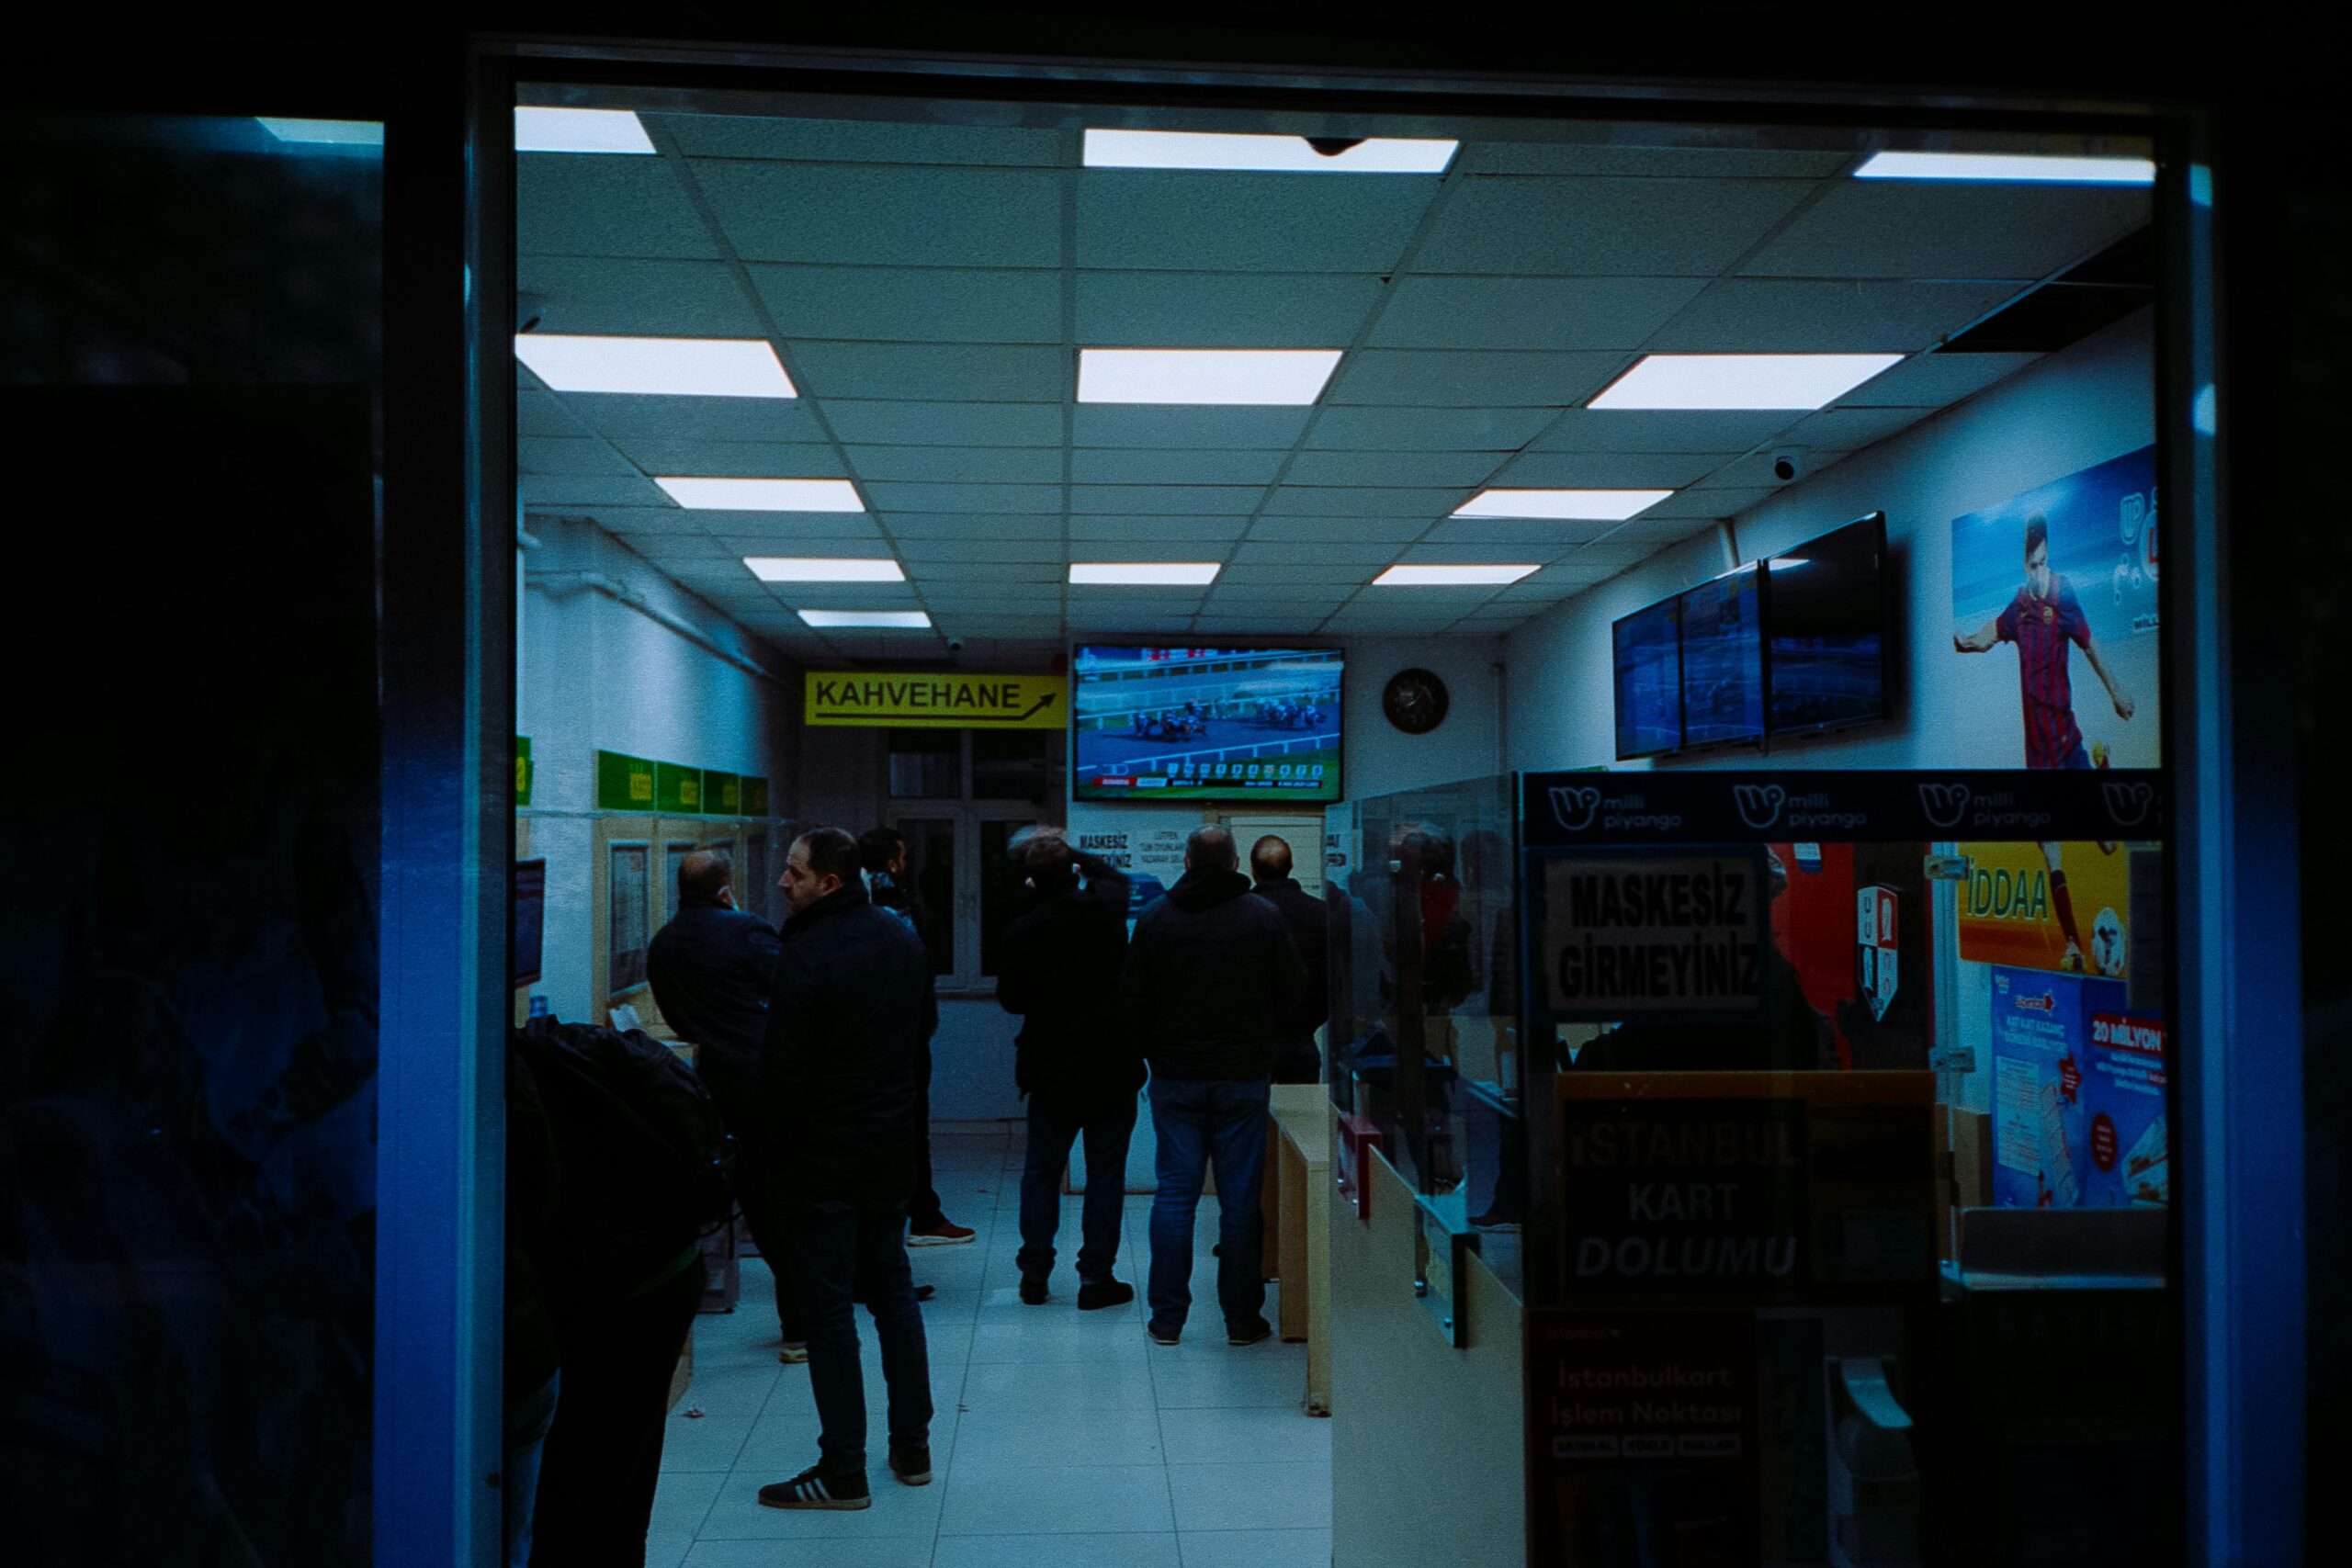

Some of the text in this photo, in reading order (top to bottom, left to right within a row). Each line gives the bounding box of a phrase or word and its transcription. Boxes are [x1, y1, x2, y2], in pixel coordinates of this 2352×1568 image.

[815, 681, 1021, 708] KAHVEHANE
[1603, 794, 1645, 809] milli
[1788, 792, 1829, 808] milli
[1973, 791, 2015, 807] milli
[1603, 813, 1683, 829] piyango
[1789, 812, 1868, 829] piyango
[1973, 811, 2052, 828] piyango
[1571, 862, 1747, 927] MASKESİZ
[1967, 856, 2049, 921] İDDAA
[1560, 931, 1761, 997] GİRMEYİNİZ
[2093, 1020, 2109, 1043] 20
[2110, 1017, 2162, 1052] MİLYON
[1627, 1182, 1742, 1222] KART
[1574, 1234, 1800, 1279] DOLUMU
[1556, 1358, 1735, 1390] İstanbulkart
[1550, 1394, 1742, 1430] İşlem Noktası
